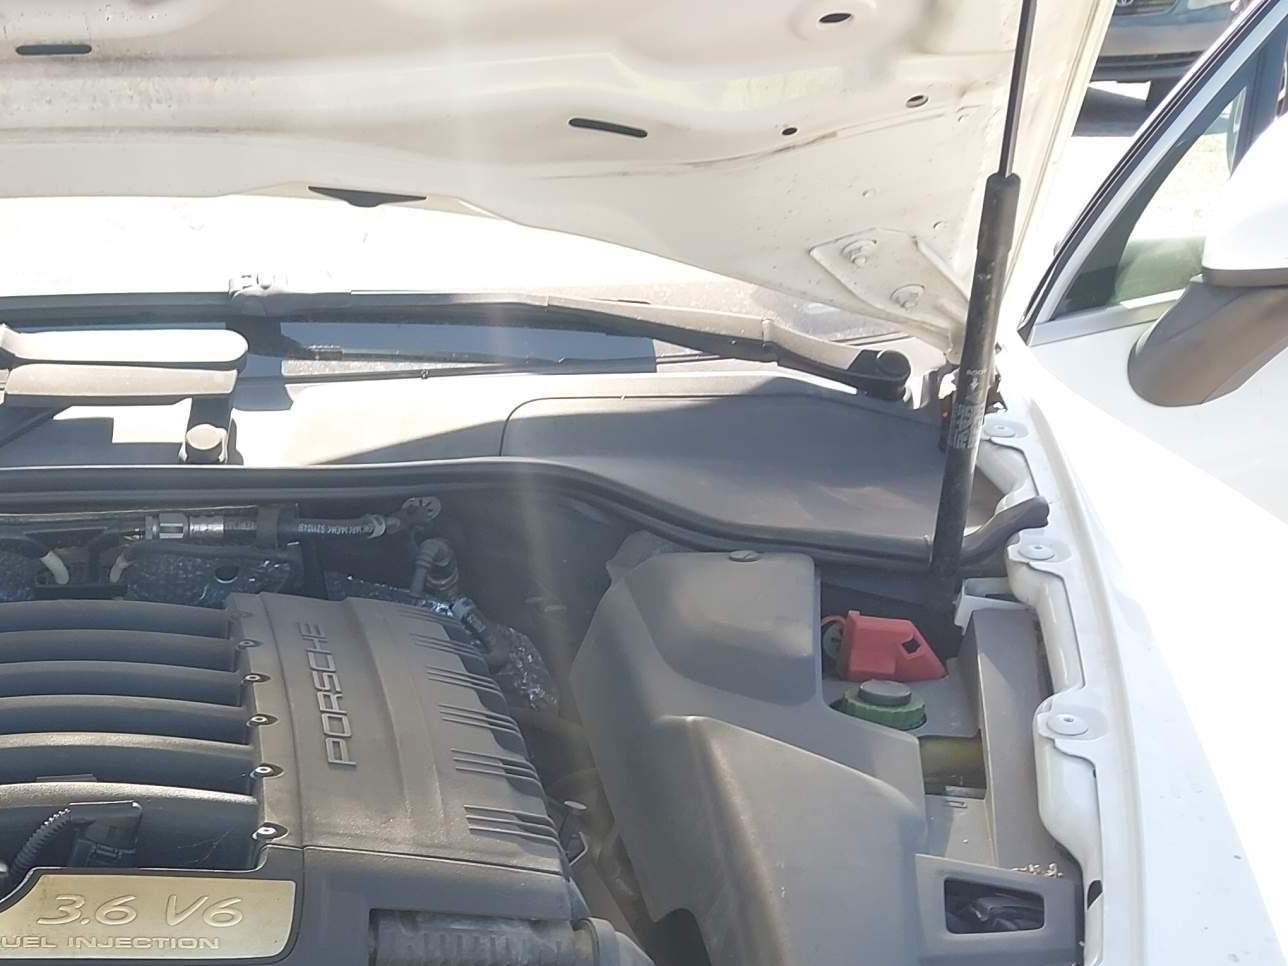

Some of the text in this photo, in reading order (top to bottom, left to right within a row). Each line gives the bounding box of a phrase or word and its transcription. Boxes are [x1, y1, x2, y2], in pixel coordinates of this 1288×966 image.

[297, 621, 358, 766] PORSCHE
[36, 894, 244, 928] 3.6 V6
[68, 936, 220, 950] INJECTION
